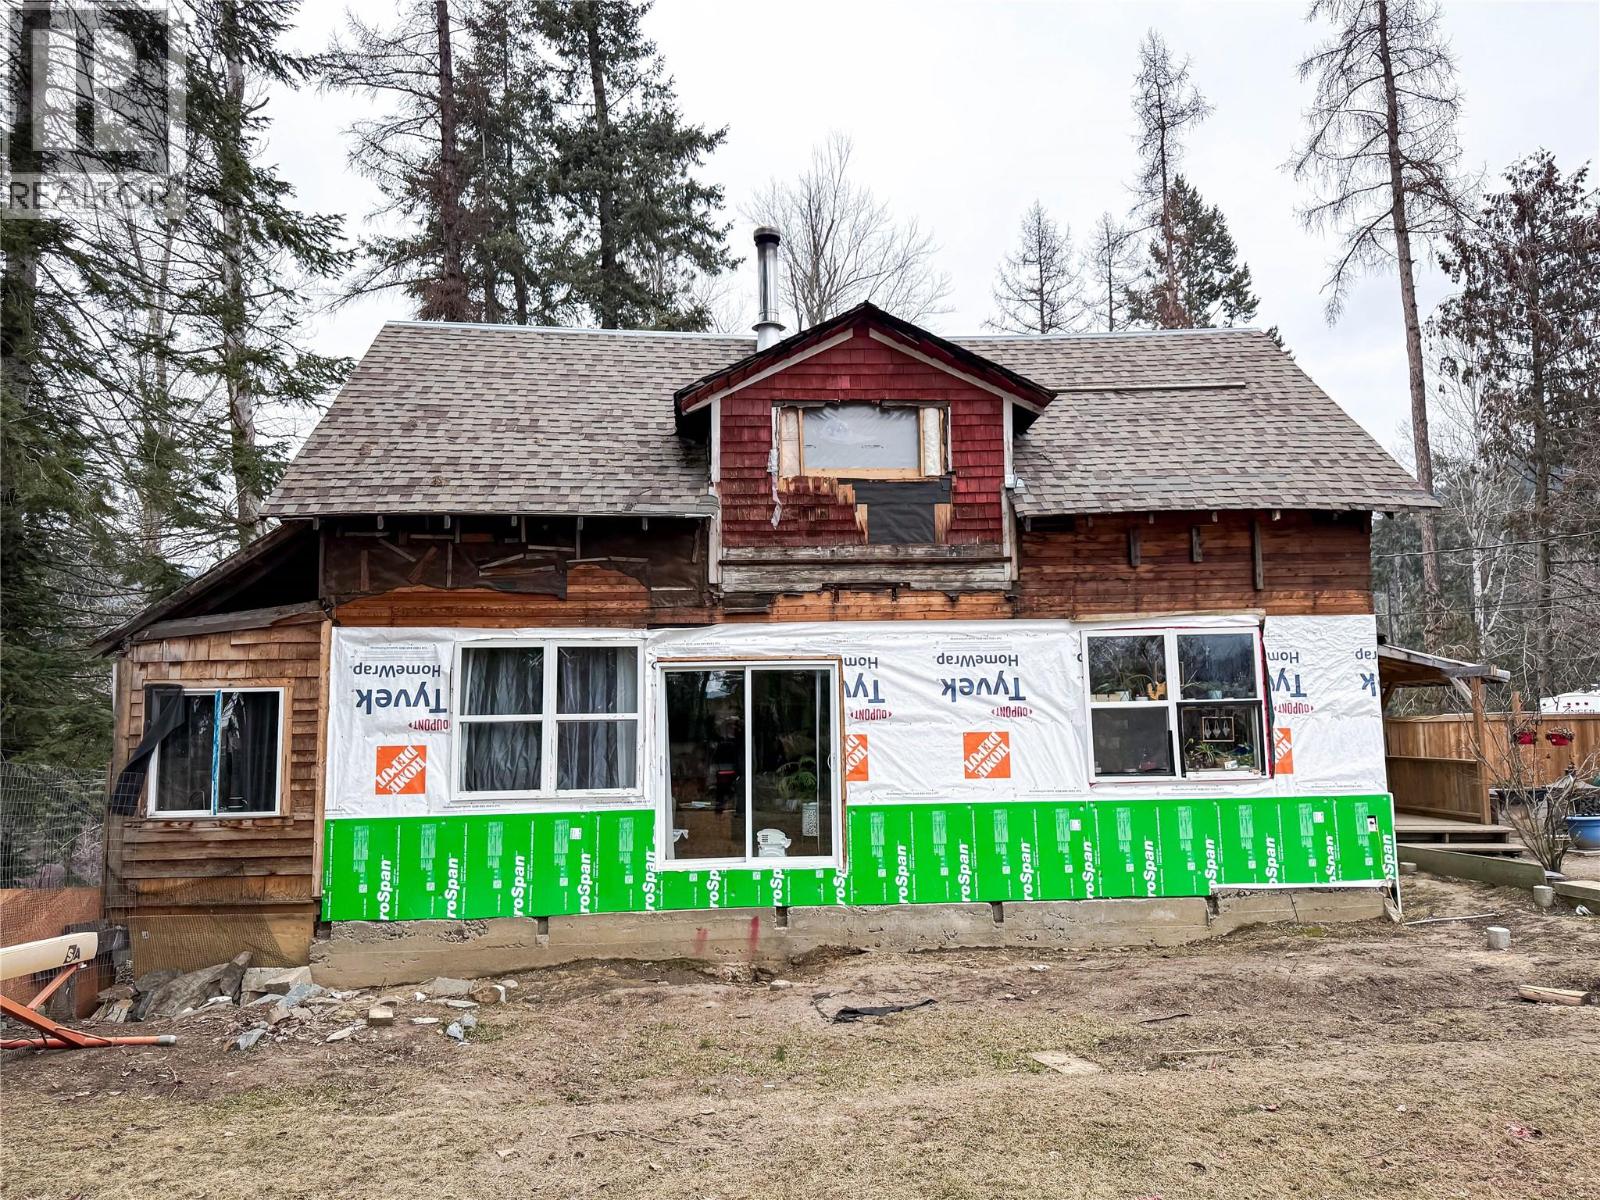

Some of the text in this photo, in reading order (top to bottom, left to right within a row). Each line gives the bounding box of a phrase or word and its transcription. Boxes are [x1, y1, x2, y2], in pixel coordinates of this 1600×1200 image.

[352, 662, 441, 678] HomeWrap
[936, 652, 1019, 667] HomeWrap
[355, 682, 448, 714] Tyvek
[940, 670, 1027, 702] Tyvek
[855, 708, 887, 721] DUPONT
[995, 705, 1028, 718] DUPONT
[1278, 702, 1310, 715] DUPONT
[413, 719, 449, 732] DUPONT
[964, 731, 1002, 773] DEPOT
[974, 743, 1011, 778] HOME
[375, 745, 419, 789] DEPOT
[386, 757, 426, 794] HOME
